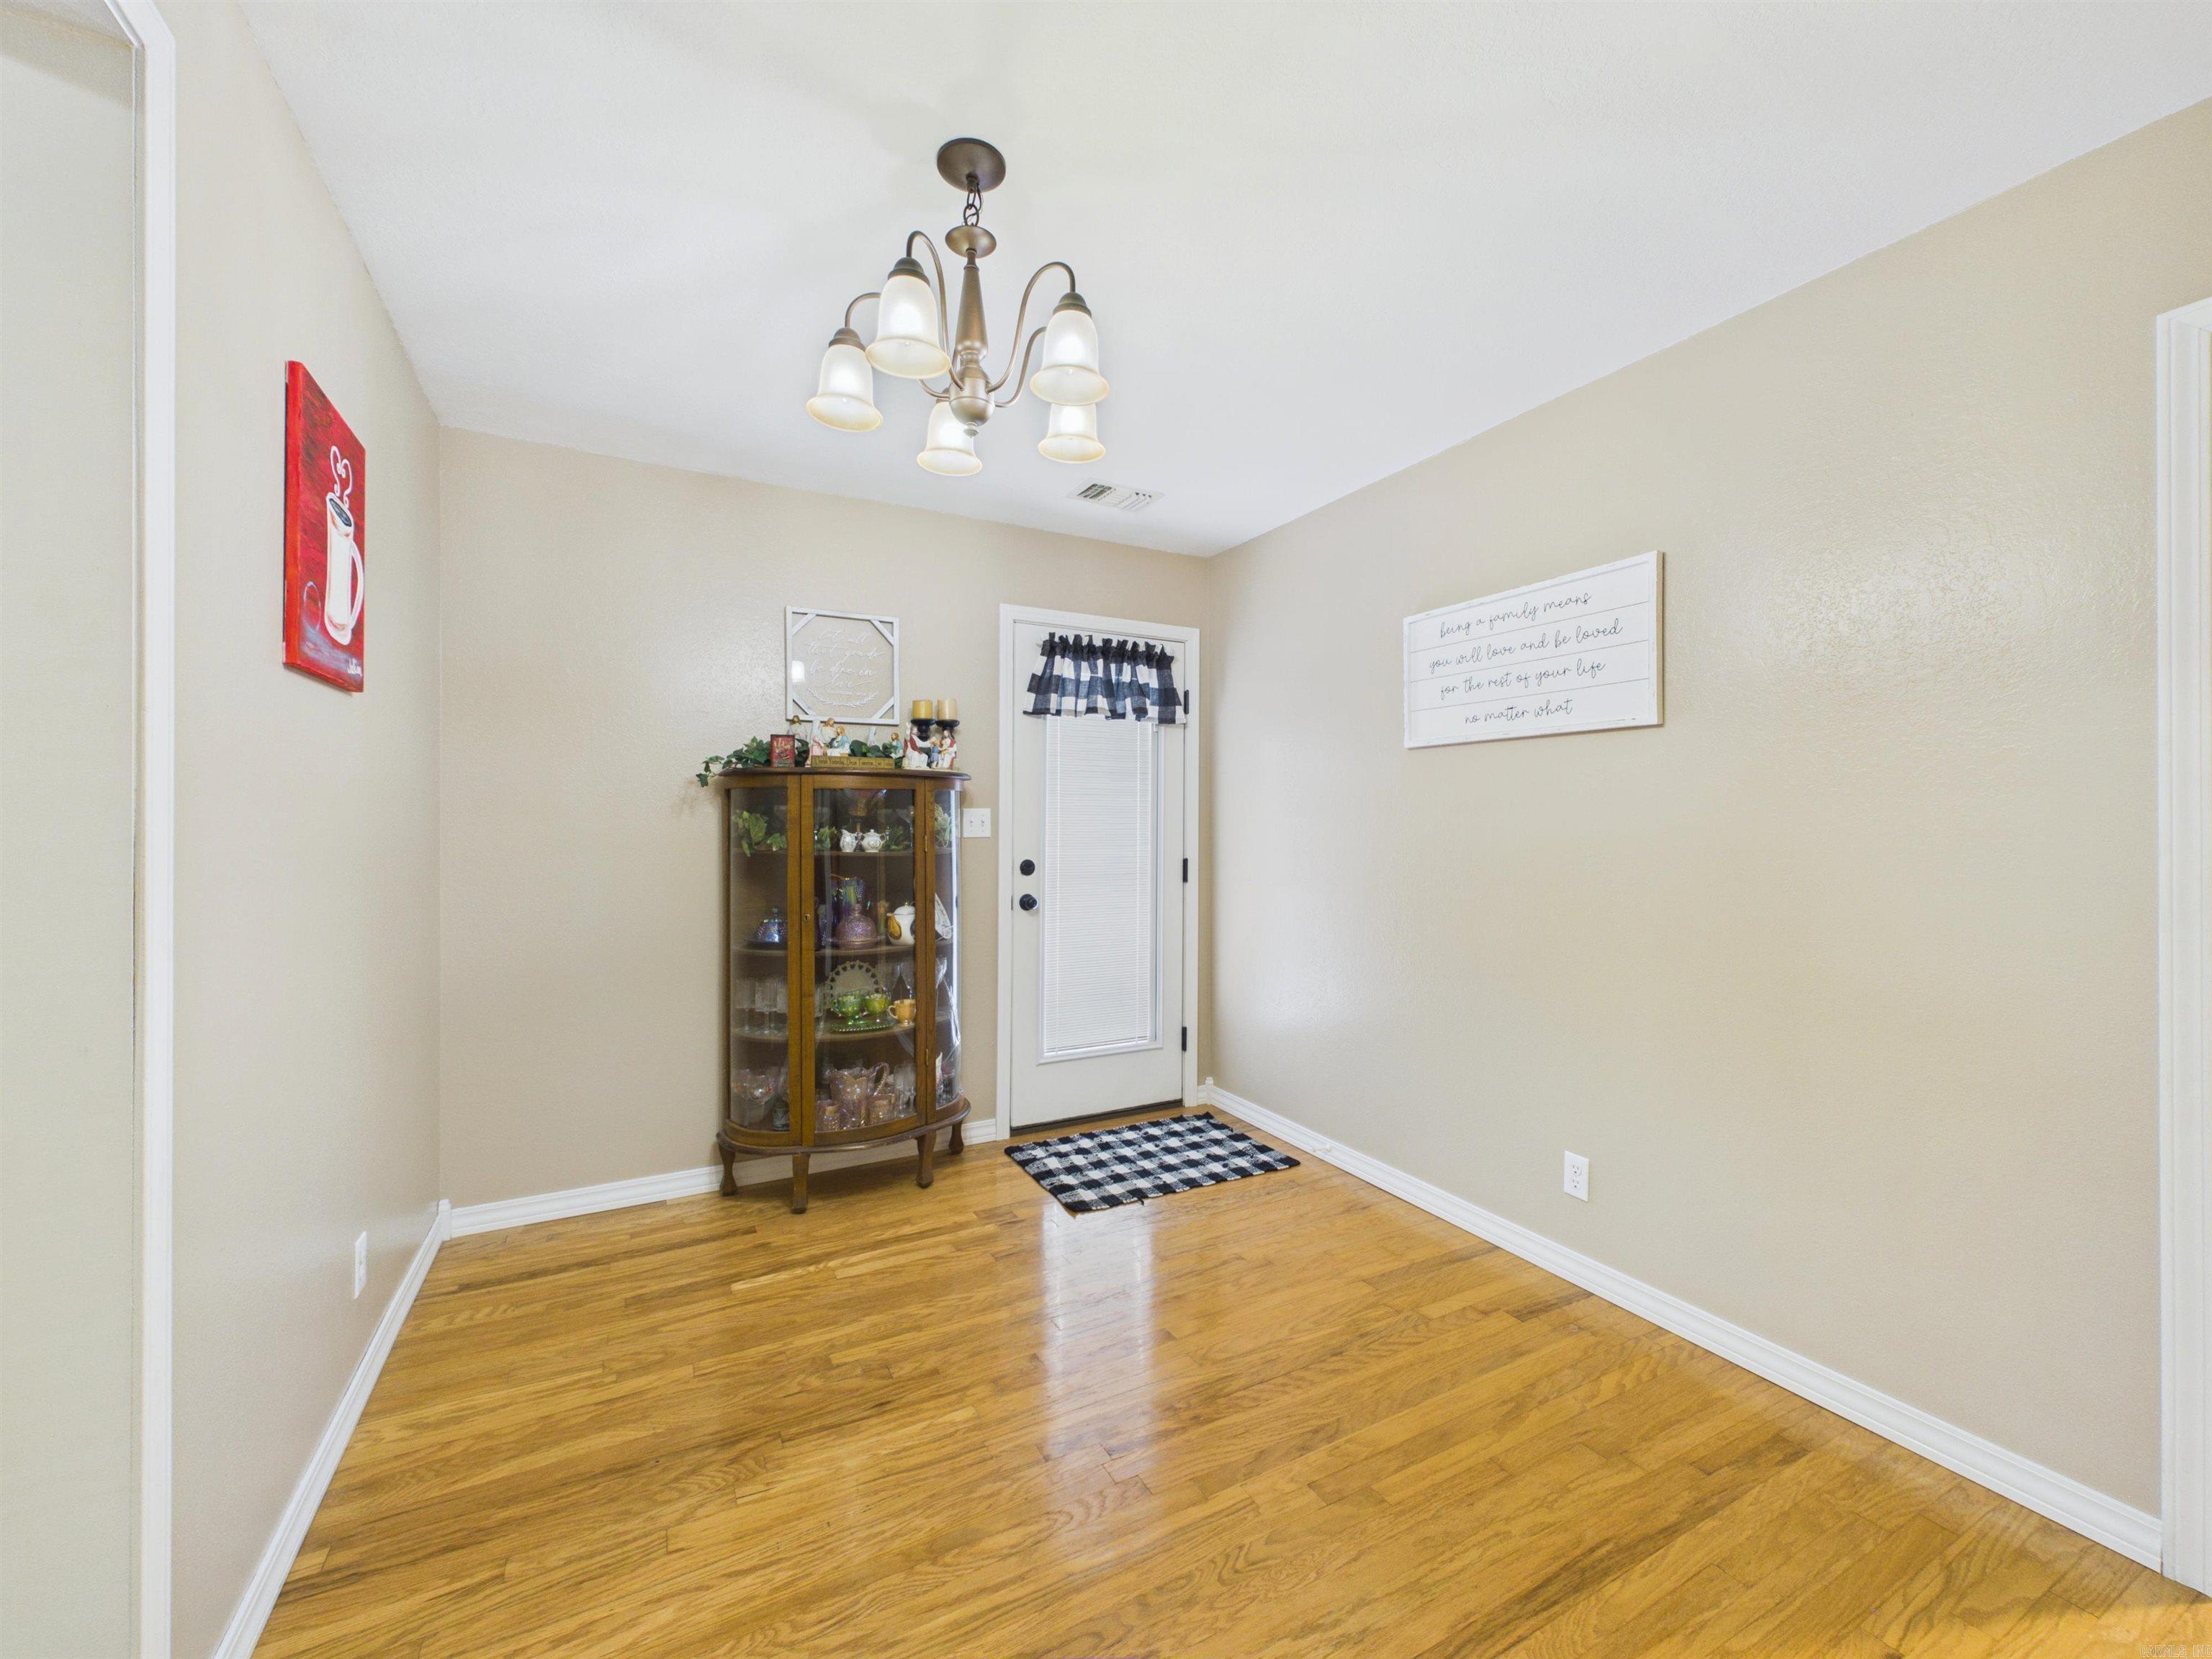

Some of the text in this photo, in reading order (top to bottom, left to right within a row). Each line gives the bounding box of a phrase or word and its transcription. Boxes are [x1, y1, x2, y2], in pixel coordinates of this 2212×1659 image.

[1440, 621, 1472, 639] being
[1489, 601, 1539, 630] family
[1543, 593, 1591, 613] means
[1429, 618, 1623, 674] you will love and be loved
[1441, 658, 1606, 701] for the rest of your life
[1465, 698, 1573, 724] no matter what
